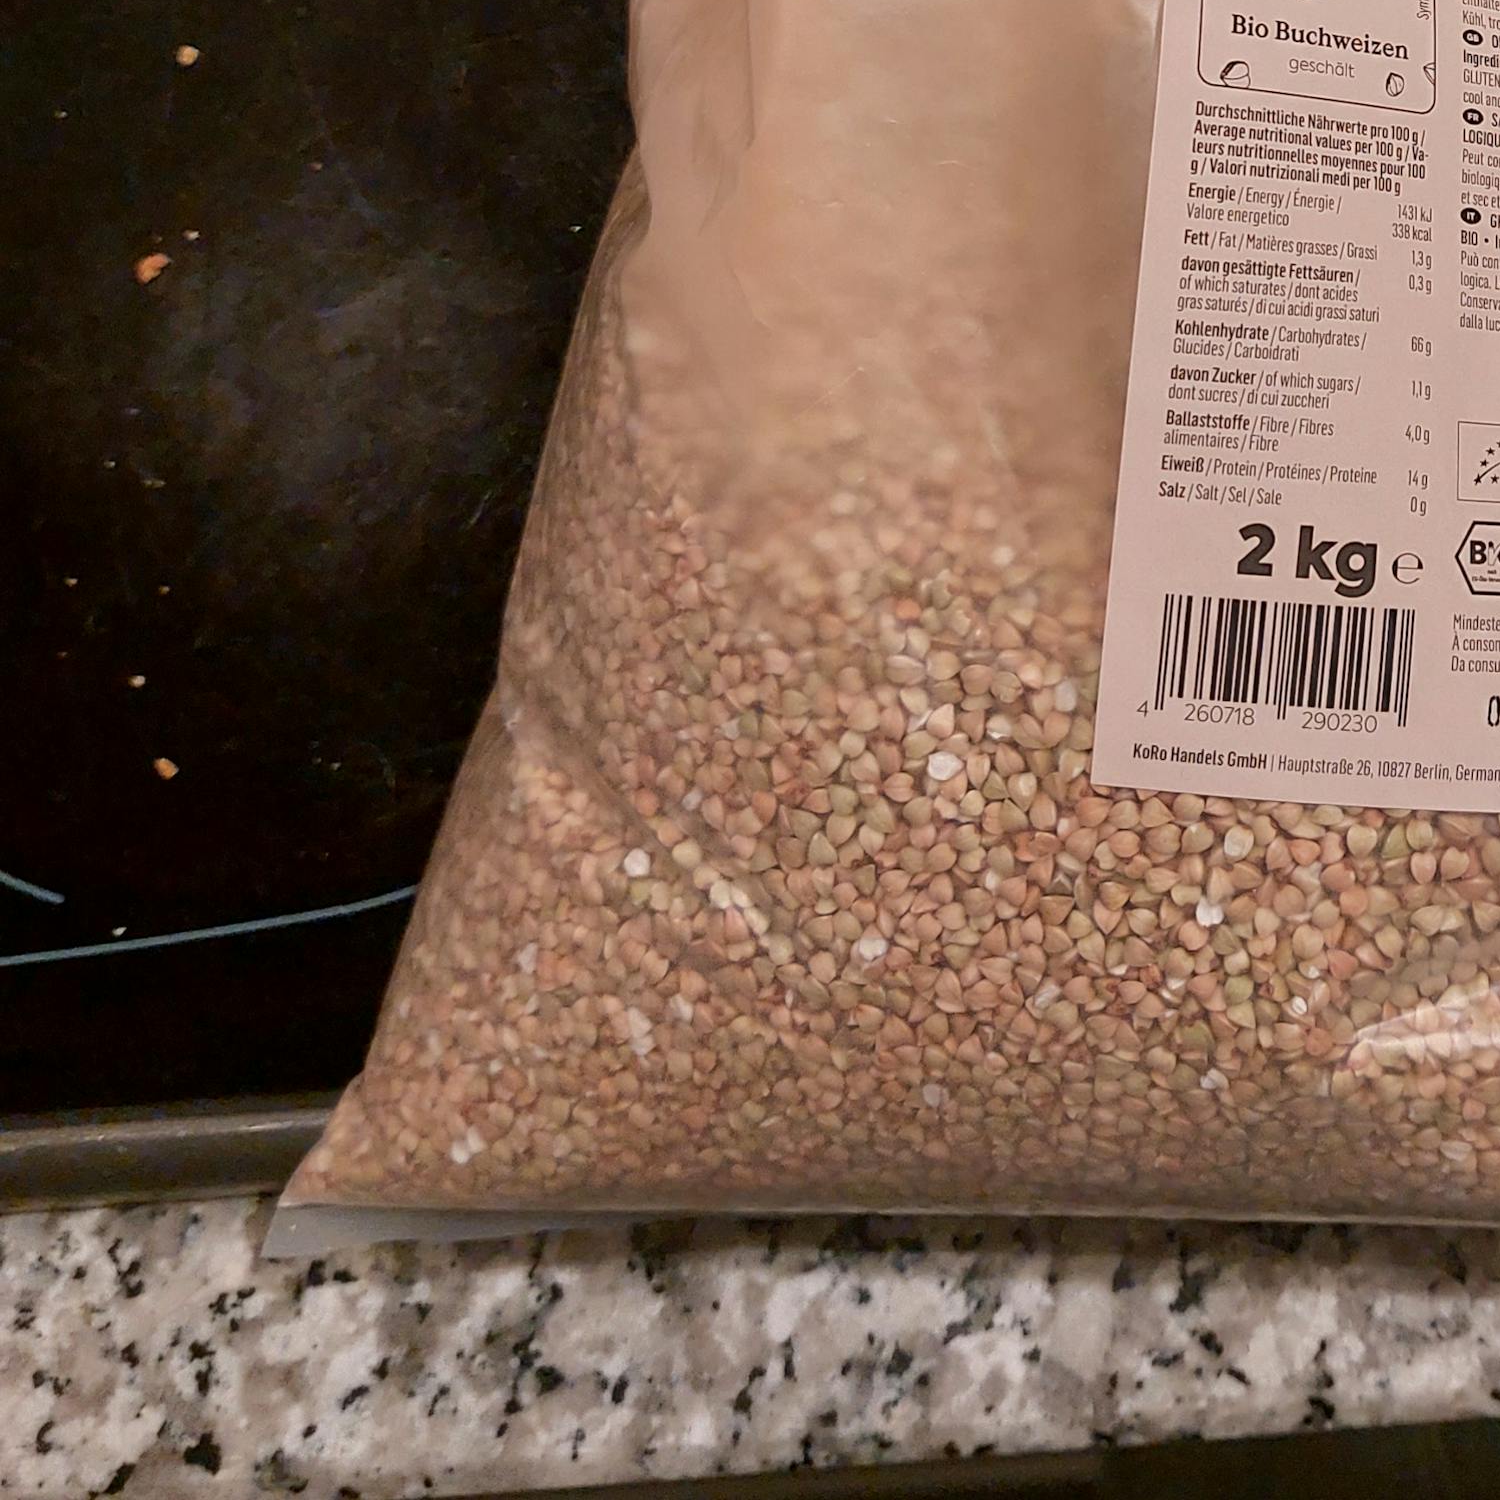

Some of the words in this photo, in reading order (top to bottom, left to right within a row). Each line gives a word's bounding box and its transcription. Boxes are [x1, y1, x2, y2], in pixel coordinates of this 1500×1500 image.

[1232, 14, 1268, 37] Bio
[1275, 21, 1409, 59] Buchweizen
[1289, 59, 1355, 77] geschält
[1196, 101, 1304, 127] Durchschnittliche
[1308, 114, 1367, 136] Nährwerte
[1392, 126, 1410, 140] 100
[1194, 120, 1245, 138] Average
[1249, 128, 1312, 146] nutritional
[1316, 136, 1352, 151] values
[1376, 141, 1393, 157] 100
[1192, 139, 1224, 155] leurs
[1228, 142, 1318, 164] nutritionnelles
[1321, 156, 1377, 173] moyennes
[1380, 163, 1404, 178] pour
[1408, 164, 1426, 179] 100
[1462, 149, 1484, 165] Peut
[1210, 157, 1246, 175] Valori
[1249, 161, 1319, 183] nutrizionali
[1322, 173, 1350, 187] medi
[1374, 178, 1391, 192] 100
[1187, 203, 1224, 222] Valore
[1228, 209, 1289, 226] energetico
[1398, 204, 1418, 220] 1431
[1421, 207, 1432, 222] kJ
[1392, 223, 1410, 239] 338
[1412, 226, 1432, 242] kcal
[1461, 230, 1478, 245] BIO
[1347, 242, 1377, 260] Grassi
[1181, 256, 1219, 273] davon
[1223, 260, 1286, 279] gesättigte
[1195, 278, 1229, 293] which
[1295, 282, 1319, 298] dont
[1323, 286, 1358, 302] acides
[1178, 296, 1202, 311] gras
[1288, 303, 1313, 317] acidi
[1316, 305, 1347, 321] grassi
[1350, 306, 1380, 322] saturi
[1234, 342, 1299, 361] Carboidrati
[1411, 337, 1423, 352] 66
[1170, 364, 1209, 382] davon
[1281, 372, 1314, 389] which
[1169, 384, 1196, 399] dont
[1281, 393, 1330, 409] zuccheri
[1300, 419, 1334, 436] Fibres
[1330, 465, 1377, 484] Proteine
[1408, 471, 1418, 486] 14
[1257, 488, 1282, 505] Sale
[1237, 523, 1275, 577] 2
[1295, 525, 1377, 598] kg
[1451, 656, 1465, 672] Da
[1184, 703, 1255, 725] 260718
[1302, 712, 1377, 733] 290230
[1133, 743, 1167, 761] KoRo
[1171, 747, 1224, 767] Handels
[1227, 751, 1267, 769] GmbH
[1278, 754, 1353, 775] Hauptstraße
[1378, 761, 1411, 778] 10827
